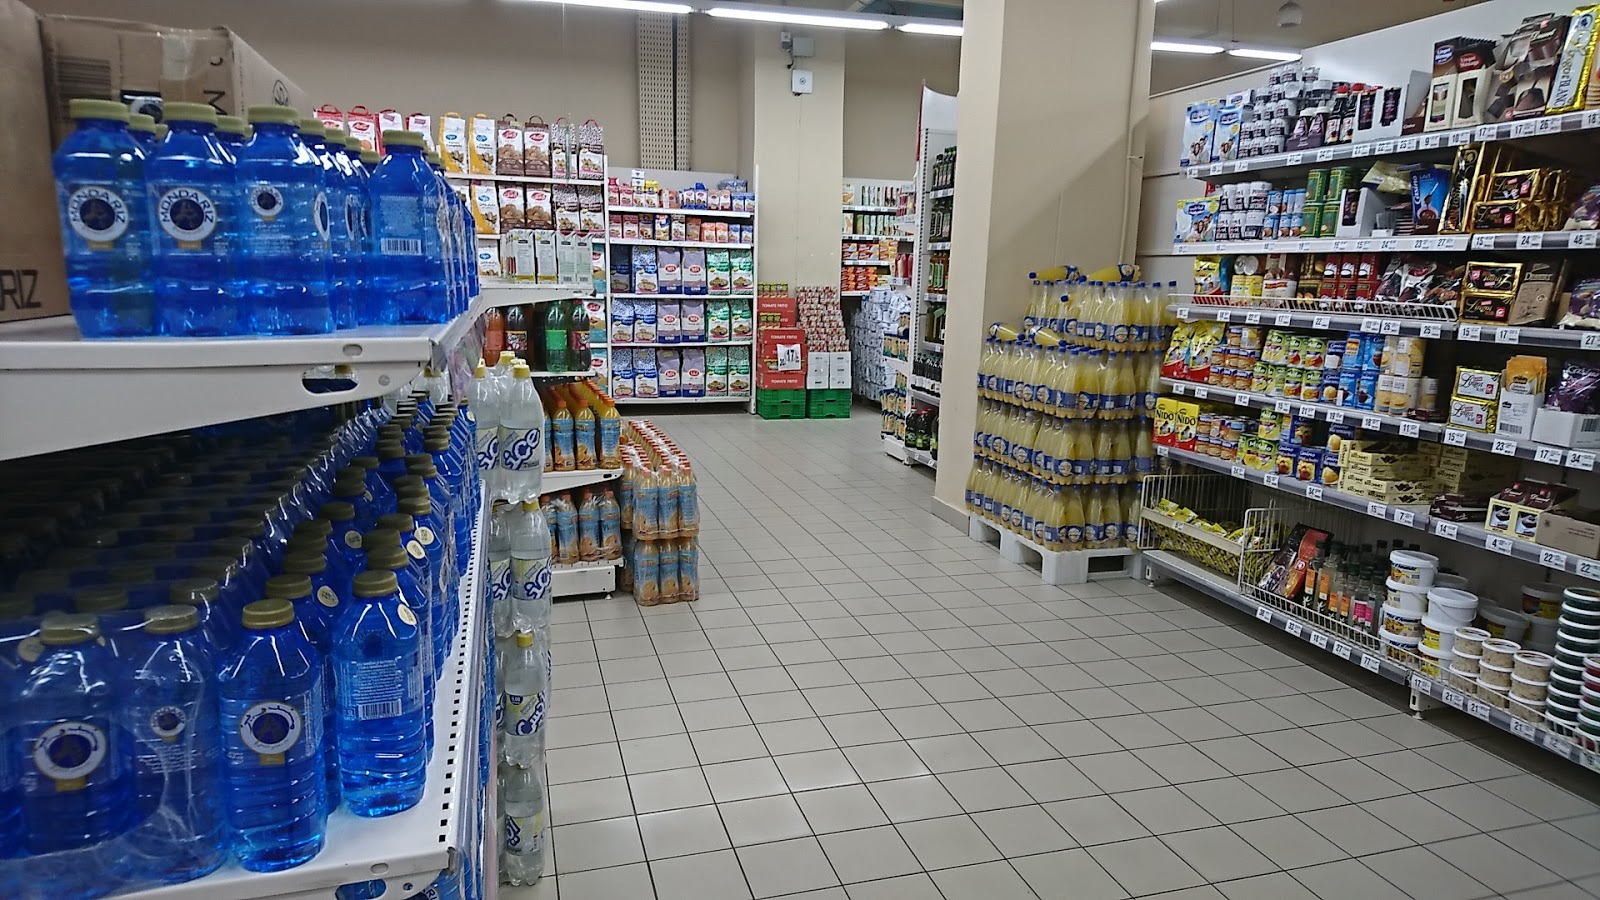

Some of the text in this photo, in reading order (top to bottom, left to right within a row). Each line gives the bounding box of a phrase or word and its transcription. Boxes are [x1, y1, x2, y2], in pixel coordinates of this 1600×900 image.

[1480, 128, 1487, 137] 17
[1516, 125, 1522, 134] 17
[1425, 137, 1430, 146] 9
[1413, 175, 1421, 205] Casino
[70, 187, 126, 223] MONDARIZ
[161, 188, 214, 223] MONDARIZ
[1437, 239, 1446, 248] 27
[1476, 237, 1484, 246] 15
[1521, 235, 1530, 245] 24
[1315, 317, 1322, 325] 22
[1462, 327, 1470, 336] 15
[1500, 330, 1507, 339] 17
[1585, 335, 1595, 345] 27
[787, 349, 794, 362] 17
[1156, 409, 1175, 421] NIDO
[1177, 414, 1196, 426] NIDO
[1403, 424, 1409, 432] 11
[1448, 432, 1455, 441] 15
[1495, 442, 1504, 451] 23
[1540, 450, 1547, 459] 17
[1572, 453, 1580, 463] 34
[1371, 505, 1377, 513] 15
[1400, 512, 1404, 520] 7
[1440, 524, 1447, 533] 14
[1491, 539, 1497, 547] 4
[1544, 552, 1553, 562] 22
[1581, 563, 1590, 573] 22
[1414, 678, 1421, 687] 17
[1445, 690, 1453, 700] 21
[1470, 702, 1478, 713] 21
[1514, 721, 1522, 731] 21
